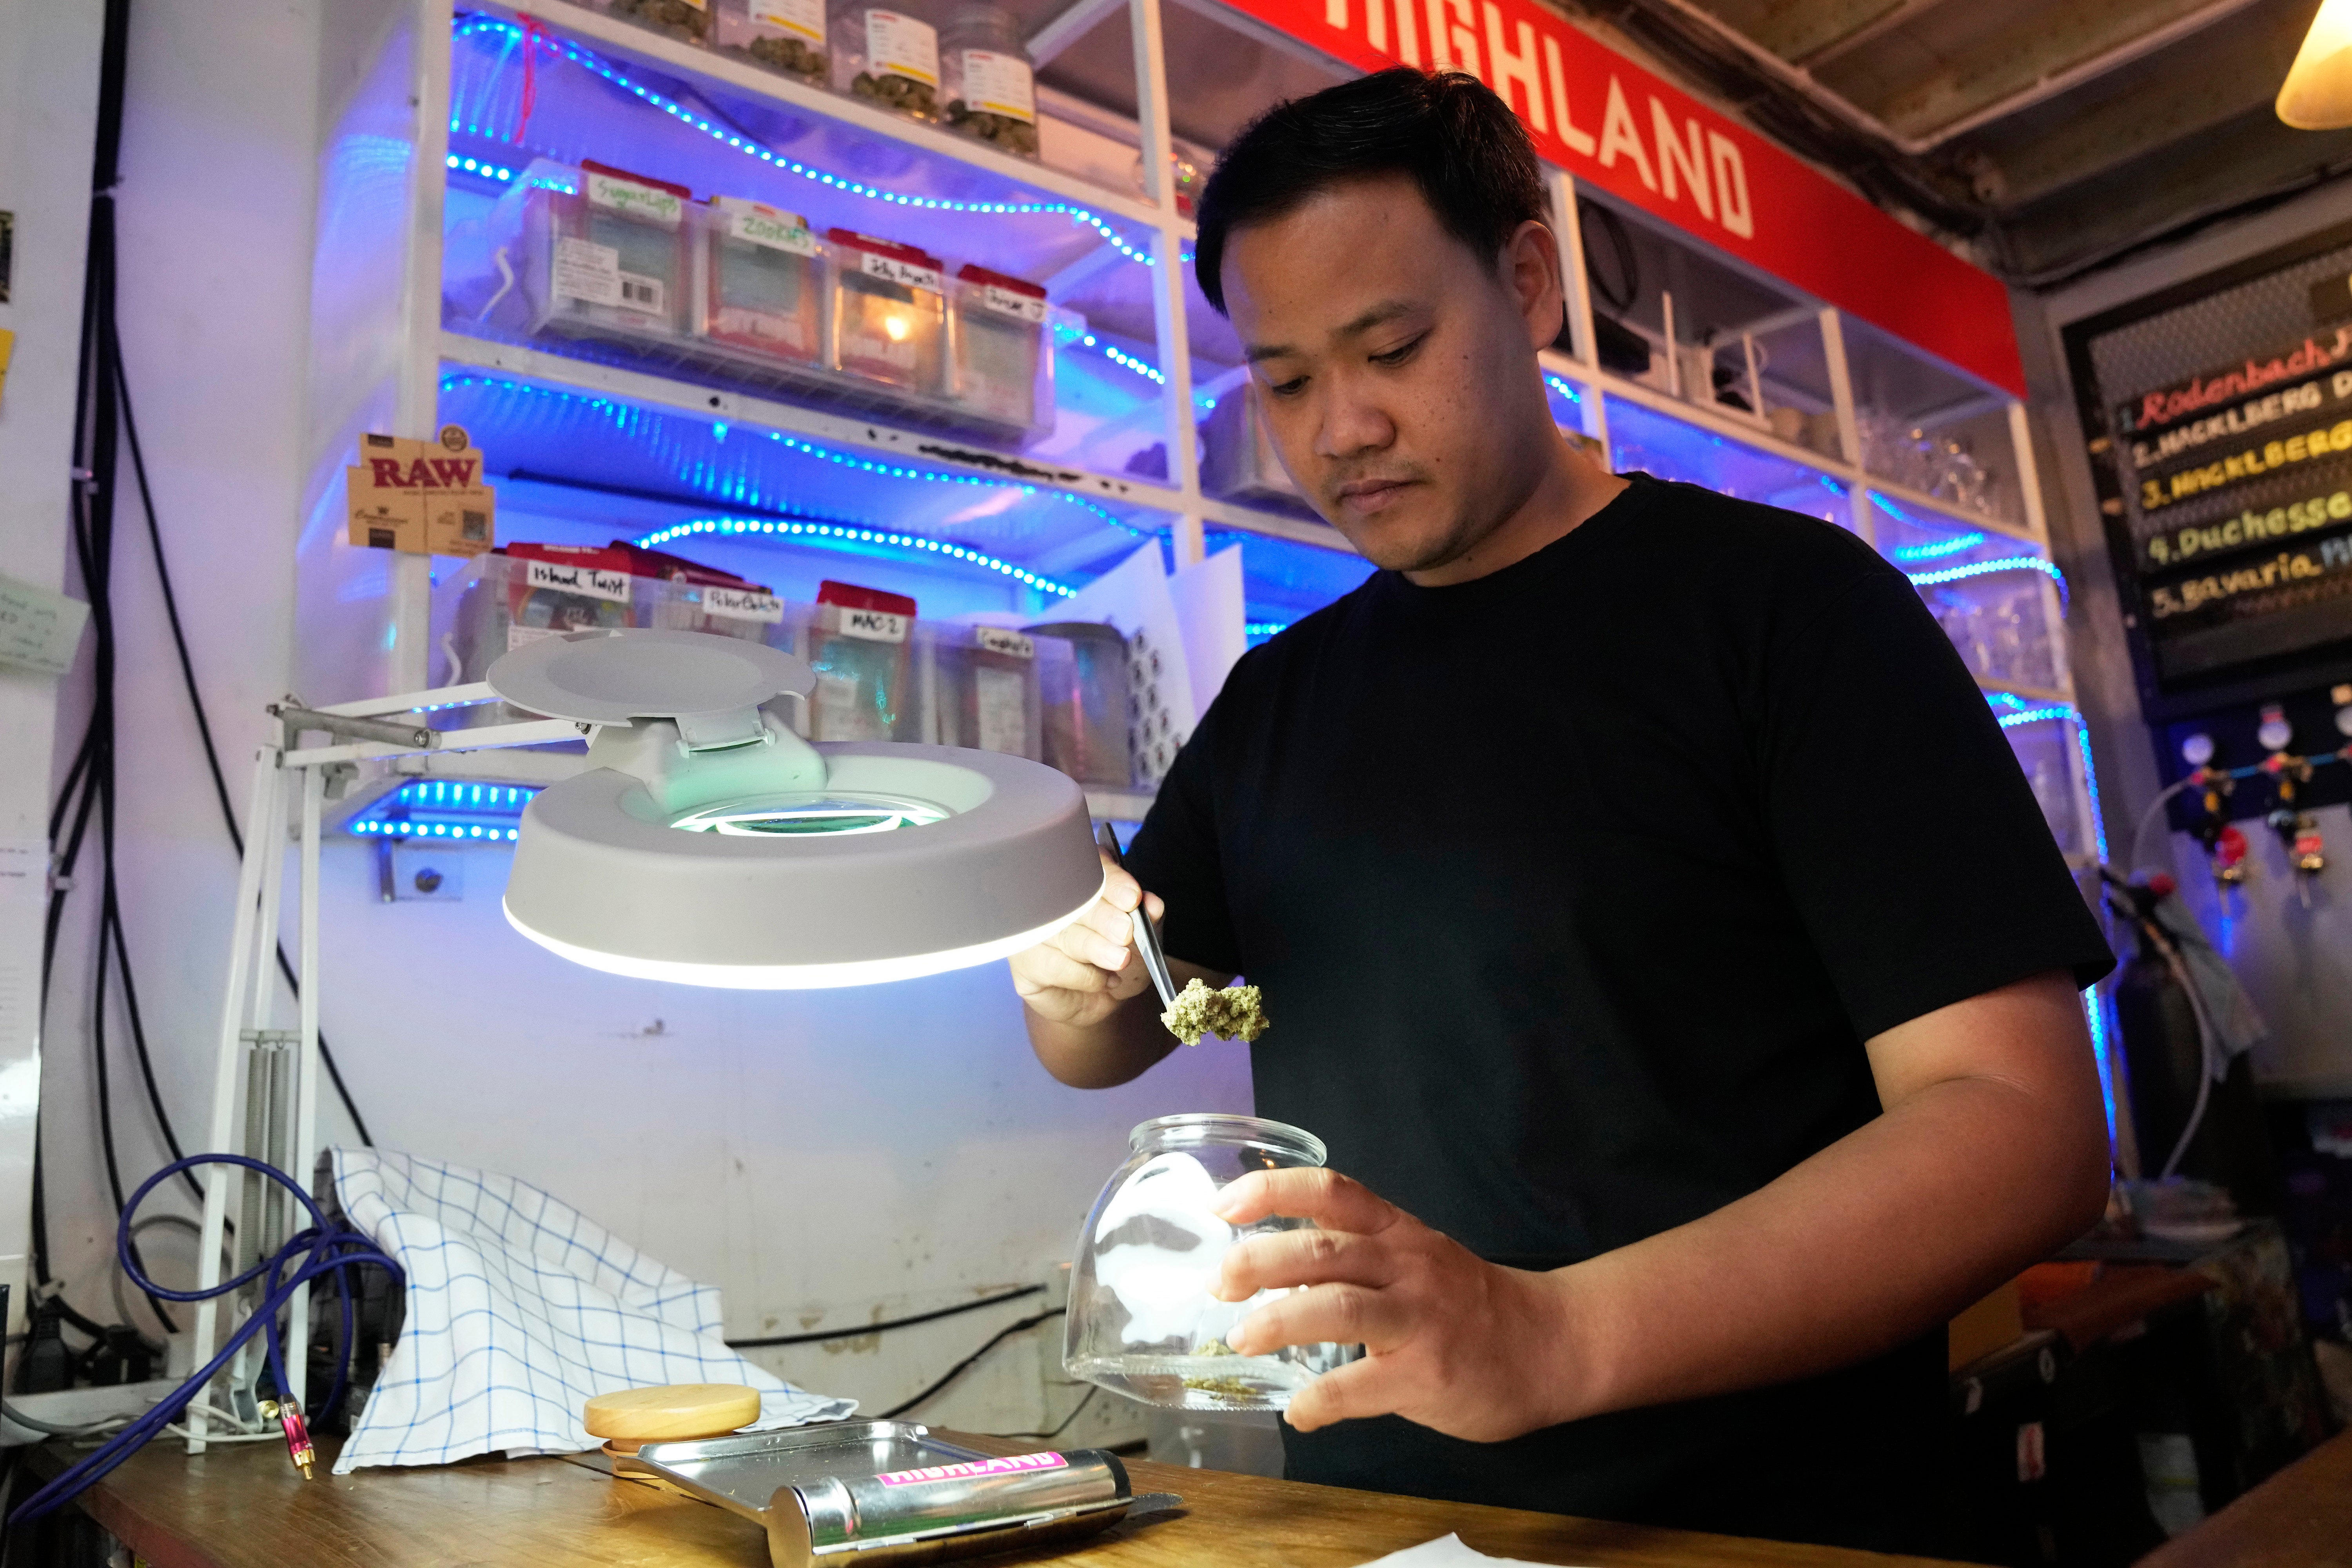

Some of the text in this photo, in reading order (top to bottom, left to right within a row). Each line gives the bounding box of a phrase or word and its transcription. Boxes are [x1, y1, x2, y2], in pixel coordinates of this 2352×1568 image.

[370, 458, 477, 488] RAW
[534, 567, 624, 595] Island Twist
